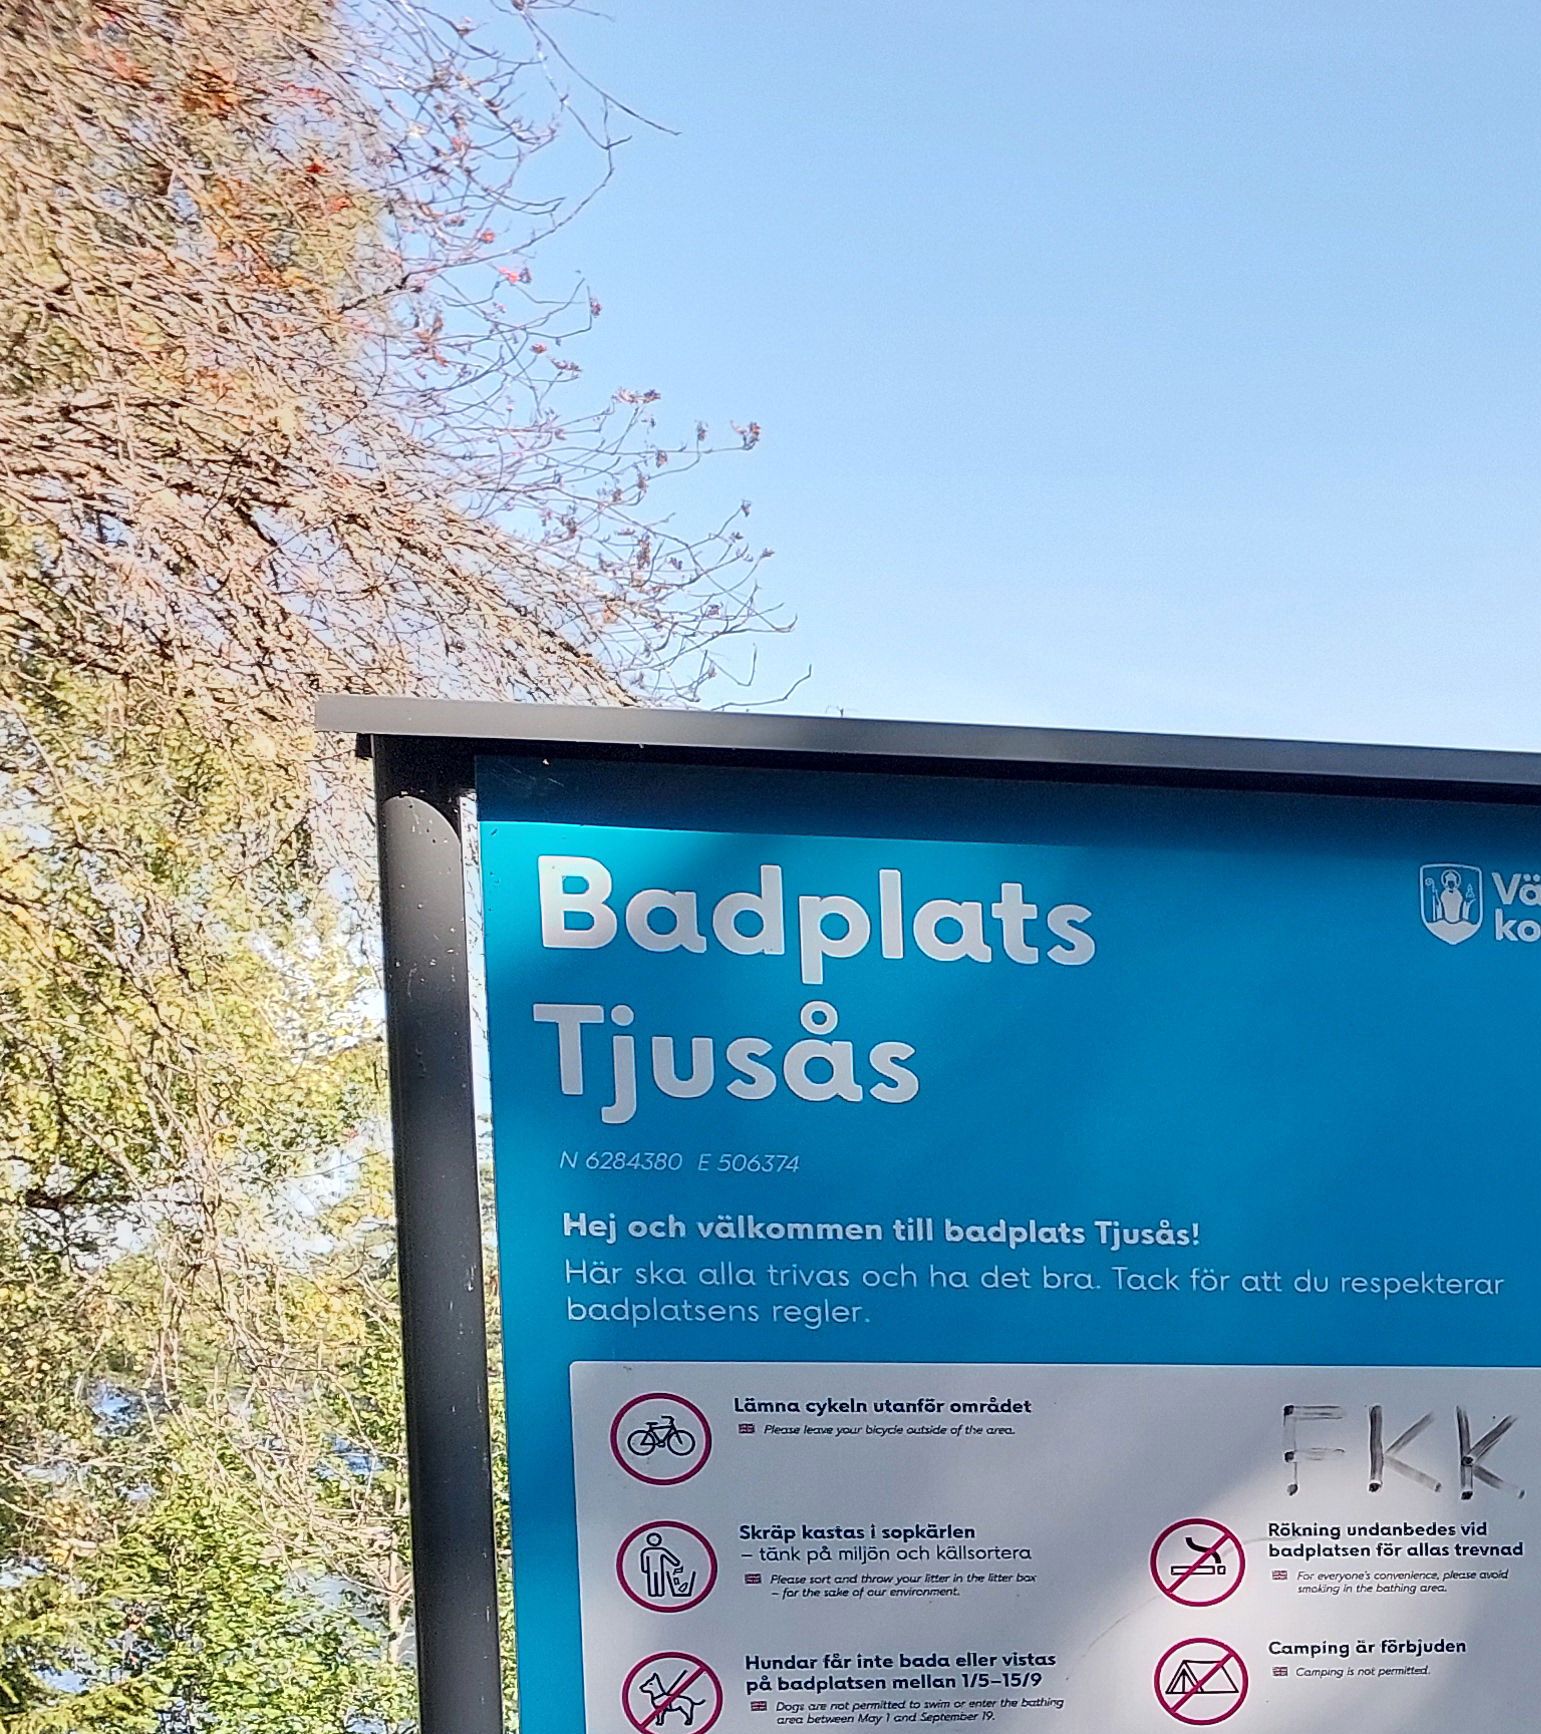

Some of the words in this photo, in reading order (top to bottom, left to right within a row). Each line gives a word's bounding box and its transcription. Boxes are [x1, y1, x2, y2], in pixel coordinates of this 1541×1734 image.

[538, 856, 1094, 984] Badplats
[533, 1001, 918, 1124] Tjusås
[559, 1150, 579, 1169] N
[585, 1151, 683, 1171] 6284380
[697, 1153, 712, 1171] E
[717, 1153, 799, 1173] 506374
[563, 1212, 617, 1245] Hej
[627, 1213, 686, 1238] och
[697, 1214, 883, 1241] välkommen
[892, 1217, 933, 1241] till
[944, 1218, 1086, 1250] badplats
[1093, 1219, 1199, 1251] Tjusås!
[565, 1258, 623, 1285] Här
[635, 1260, 687, 1285] ska
[698, 1261, 756, 1286] alla
[767, 1264, 850, 1287] trivas
[862, 1263, 917, 1287] och
[930, 1264, 969, 1288] ha
[980, 1265, 1031, 1289] det
[1043, 1265, 1102, 1290] bra.
[1111, 1266, 1180, 1291] Tack
[1189, 1267, 1231, 1292] för
[1241, 1270, 1283, 1292] att
[1293, 1269, 1329, 1293] du
[1341, 1271, 1505, 1300] respekterar
[567, 1295, 760, 1328] badplatsens
[772, 1298, 871, 1330] regler.
[734, 1397, 801, 1413] Lämna
[805, 1397, 868, 1417] cykeln
[873, 1397, 945, 1413] utanför
[949, 1396, 1032, 1413] området
[1282, 1404, 1527, 1500] FKK
[739, 1524, 797, 1544] Skräp
[801, 1524, 865, 1540] kastas
[870, 1523, 876, 1539] i
[881, 1523, 975, 1543] sopkärlen
[1268, 1522, 1341, 1541] Rökning
[1347, 1521, 1456, 1537] undanbedes
[1460, 1521, 1487, 1537] vid
[759, 1544, 801, 1561] tänk
[807, 1545, 833, 1565] på
[838, 1545, 890, 1565] miljön
[896, 1545, 930, 1561] och
[936, 1544, 1033, 1561] källsortera
[1269, 1543, 1371, 1562] badplatsen
[1375, 1542, 1403, 1557] för
[1406, 1542, 1450, 1557] allas
[1454, 1541, 1523, 1557] trevnad
[1268, 1640, 1350, 1659] Camping
[1355, 1639, 1376, 1654] är
[1381, 1638, 1466, 1657] förbjuden
[745, 1654, 818, 1671] Hundar
[822, 1652, 852, 1669] får
[857, 1653, 894, 1669] inte
[899, 1652, 951, 1668] bada
[955, 1651, 998, 1667] eller
[1001, 1651, 1057, 1667] vistas
[1295, 1667, 1345, 1679] Camping
[1346, 1666, 1355, 1676] is
[1357, 1668, 1376, 1676] not
[1377, 1664, 1431, 1678] permitted.
[746, 1674, 773, 1696] på
[777, 1675, 887, 1695] badplatsen
[892, 1673, 956, 1689] mellan
